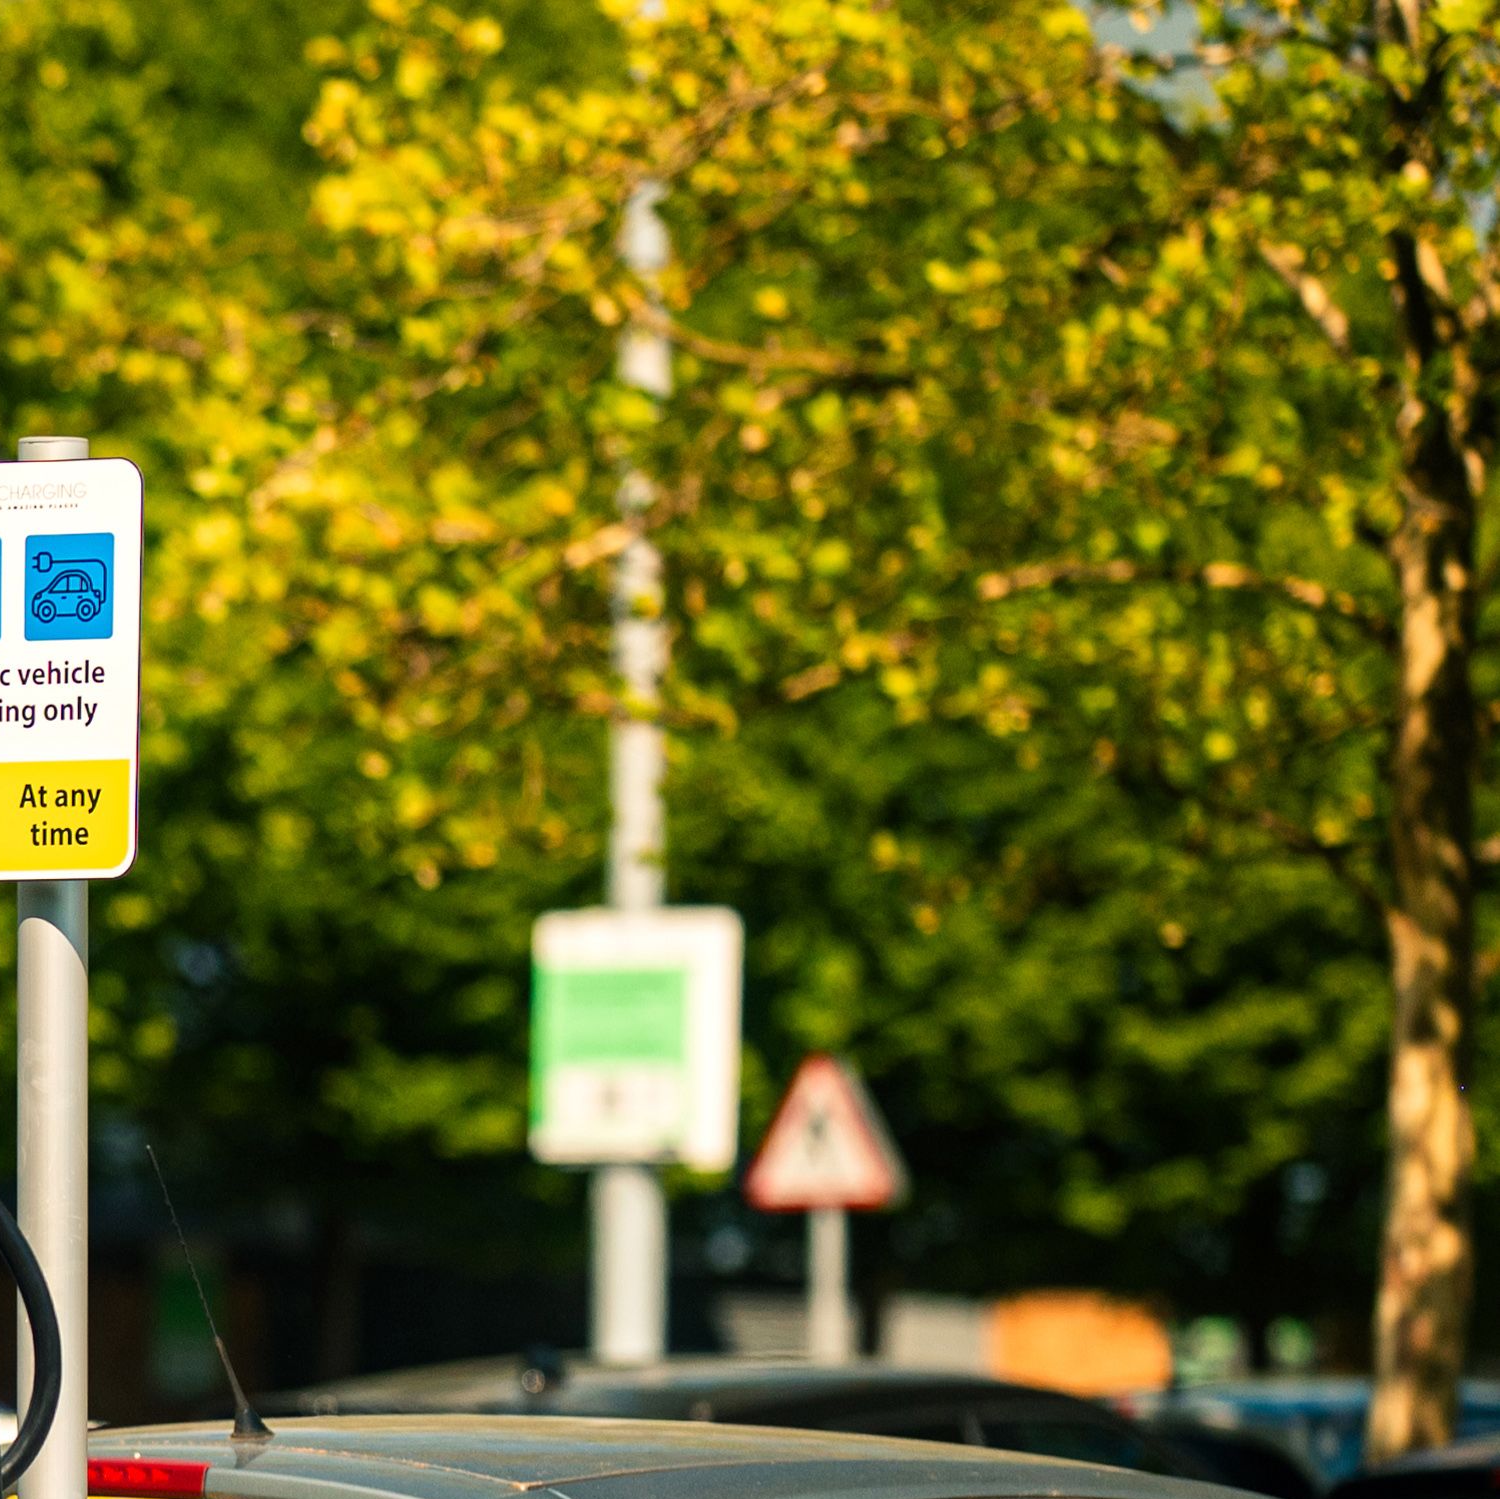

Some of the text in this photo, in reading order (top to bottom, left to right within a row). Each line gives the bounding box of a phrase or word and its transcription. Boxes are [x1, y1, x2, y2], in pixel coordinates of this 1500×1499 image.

[18, 660, 105, 686] vehicle
[44, 697, 98, 727] only
[19, 784, 101, 814] At any
[31, 820, 89, 847] time
